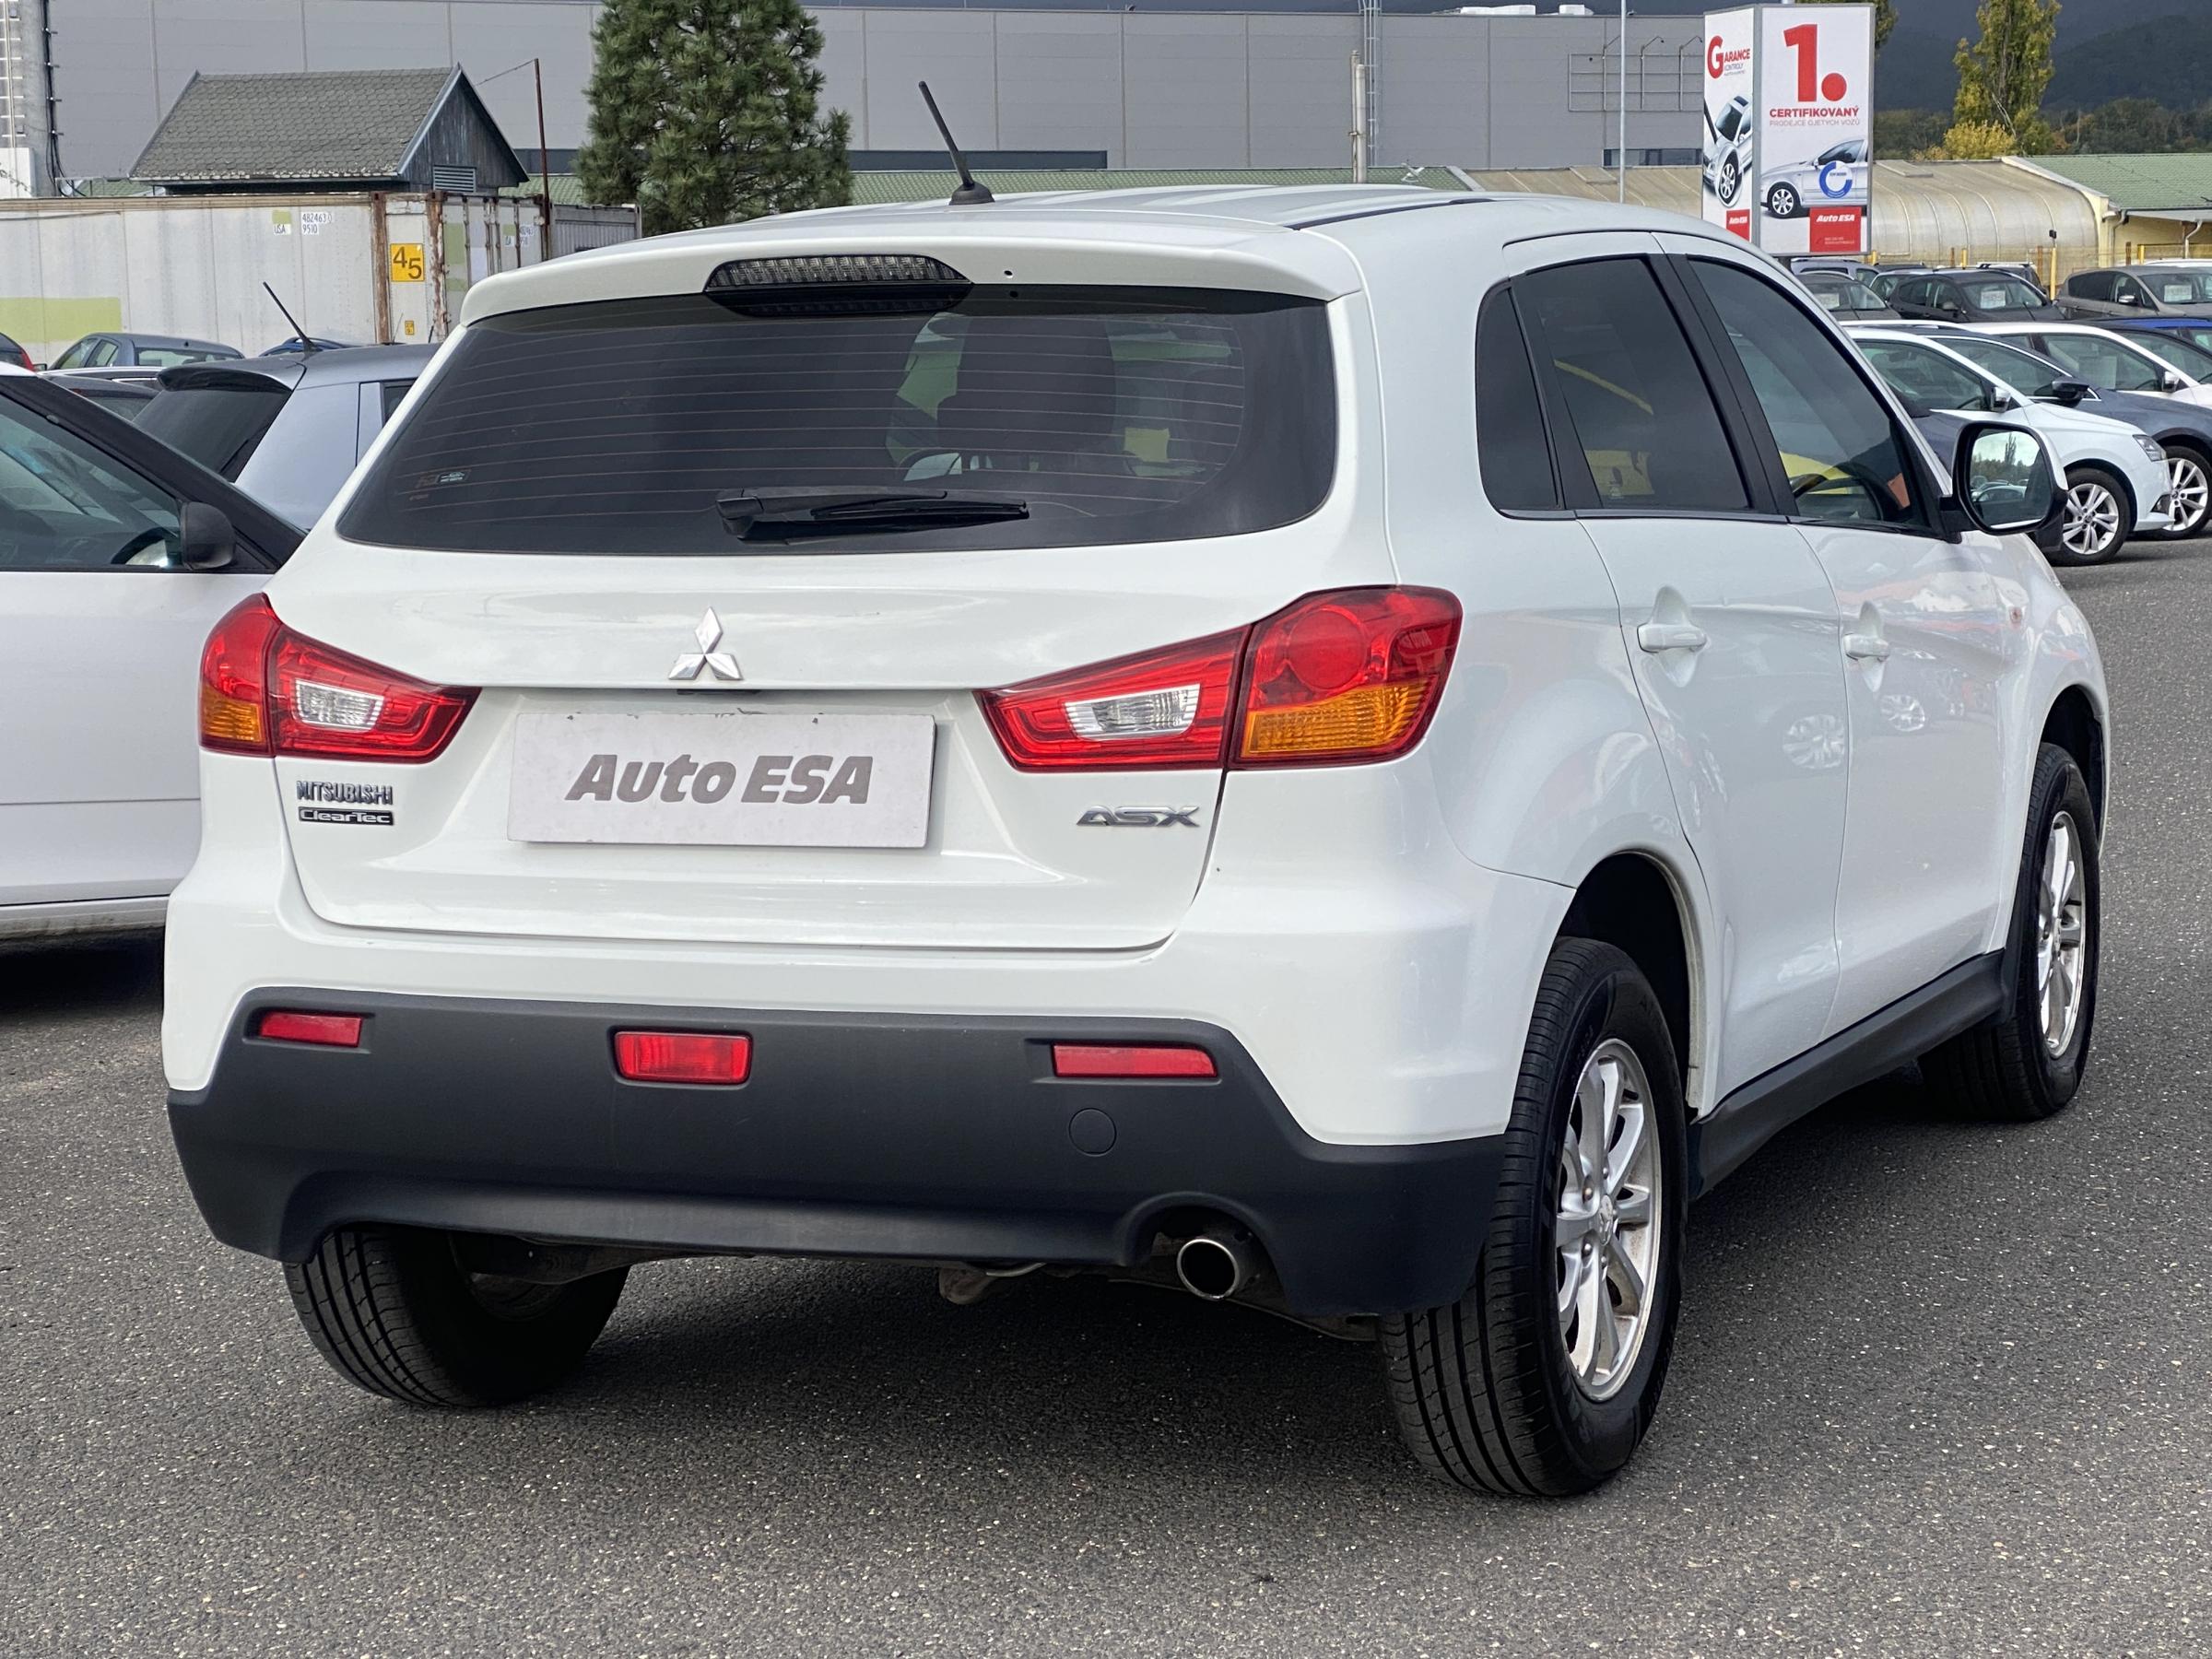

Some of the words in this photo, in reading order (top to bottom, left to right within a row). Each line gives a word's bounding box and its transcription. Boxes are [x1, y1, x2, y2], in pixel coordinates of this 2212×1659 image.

[1707, 35, 1750, 78] GARANCE
[1783, 24, 1847, 102] 1.
[1770, 106, 1859, 118] CERTIFIKOVANÝ
[1817, 214, 1839, 222] Auto
[1839, 214, 1855, 222] ESA
[564, 754, 737, 805] Auto
[740, 756, 875, 805] ESA
[296, 781, 394, 806] MITSUBISHI
[300, 809, 391, 823] ClearTec
[1076, 805, 1201, 828] ASX
